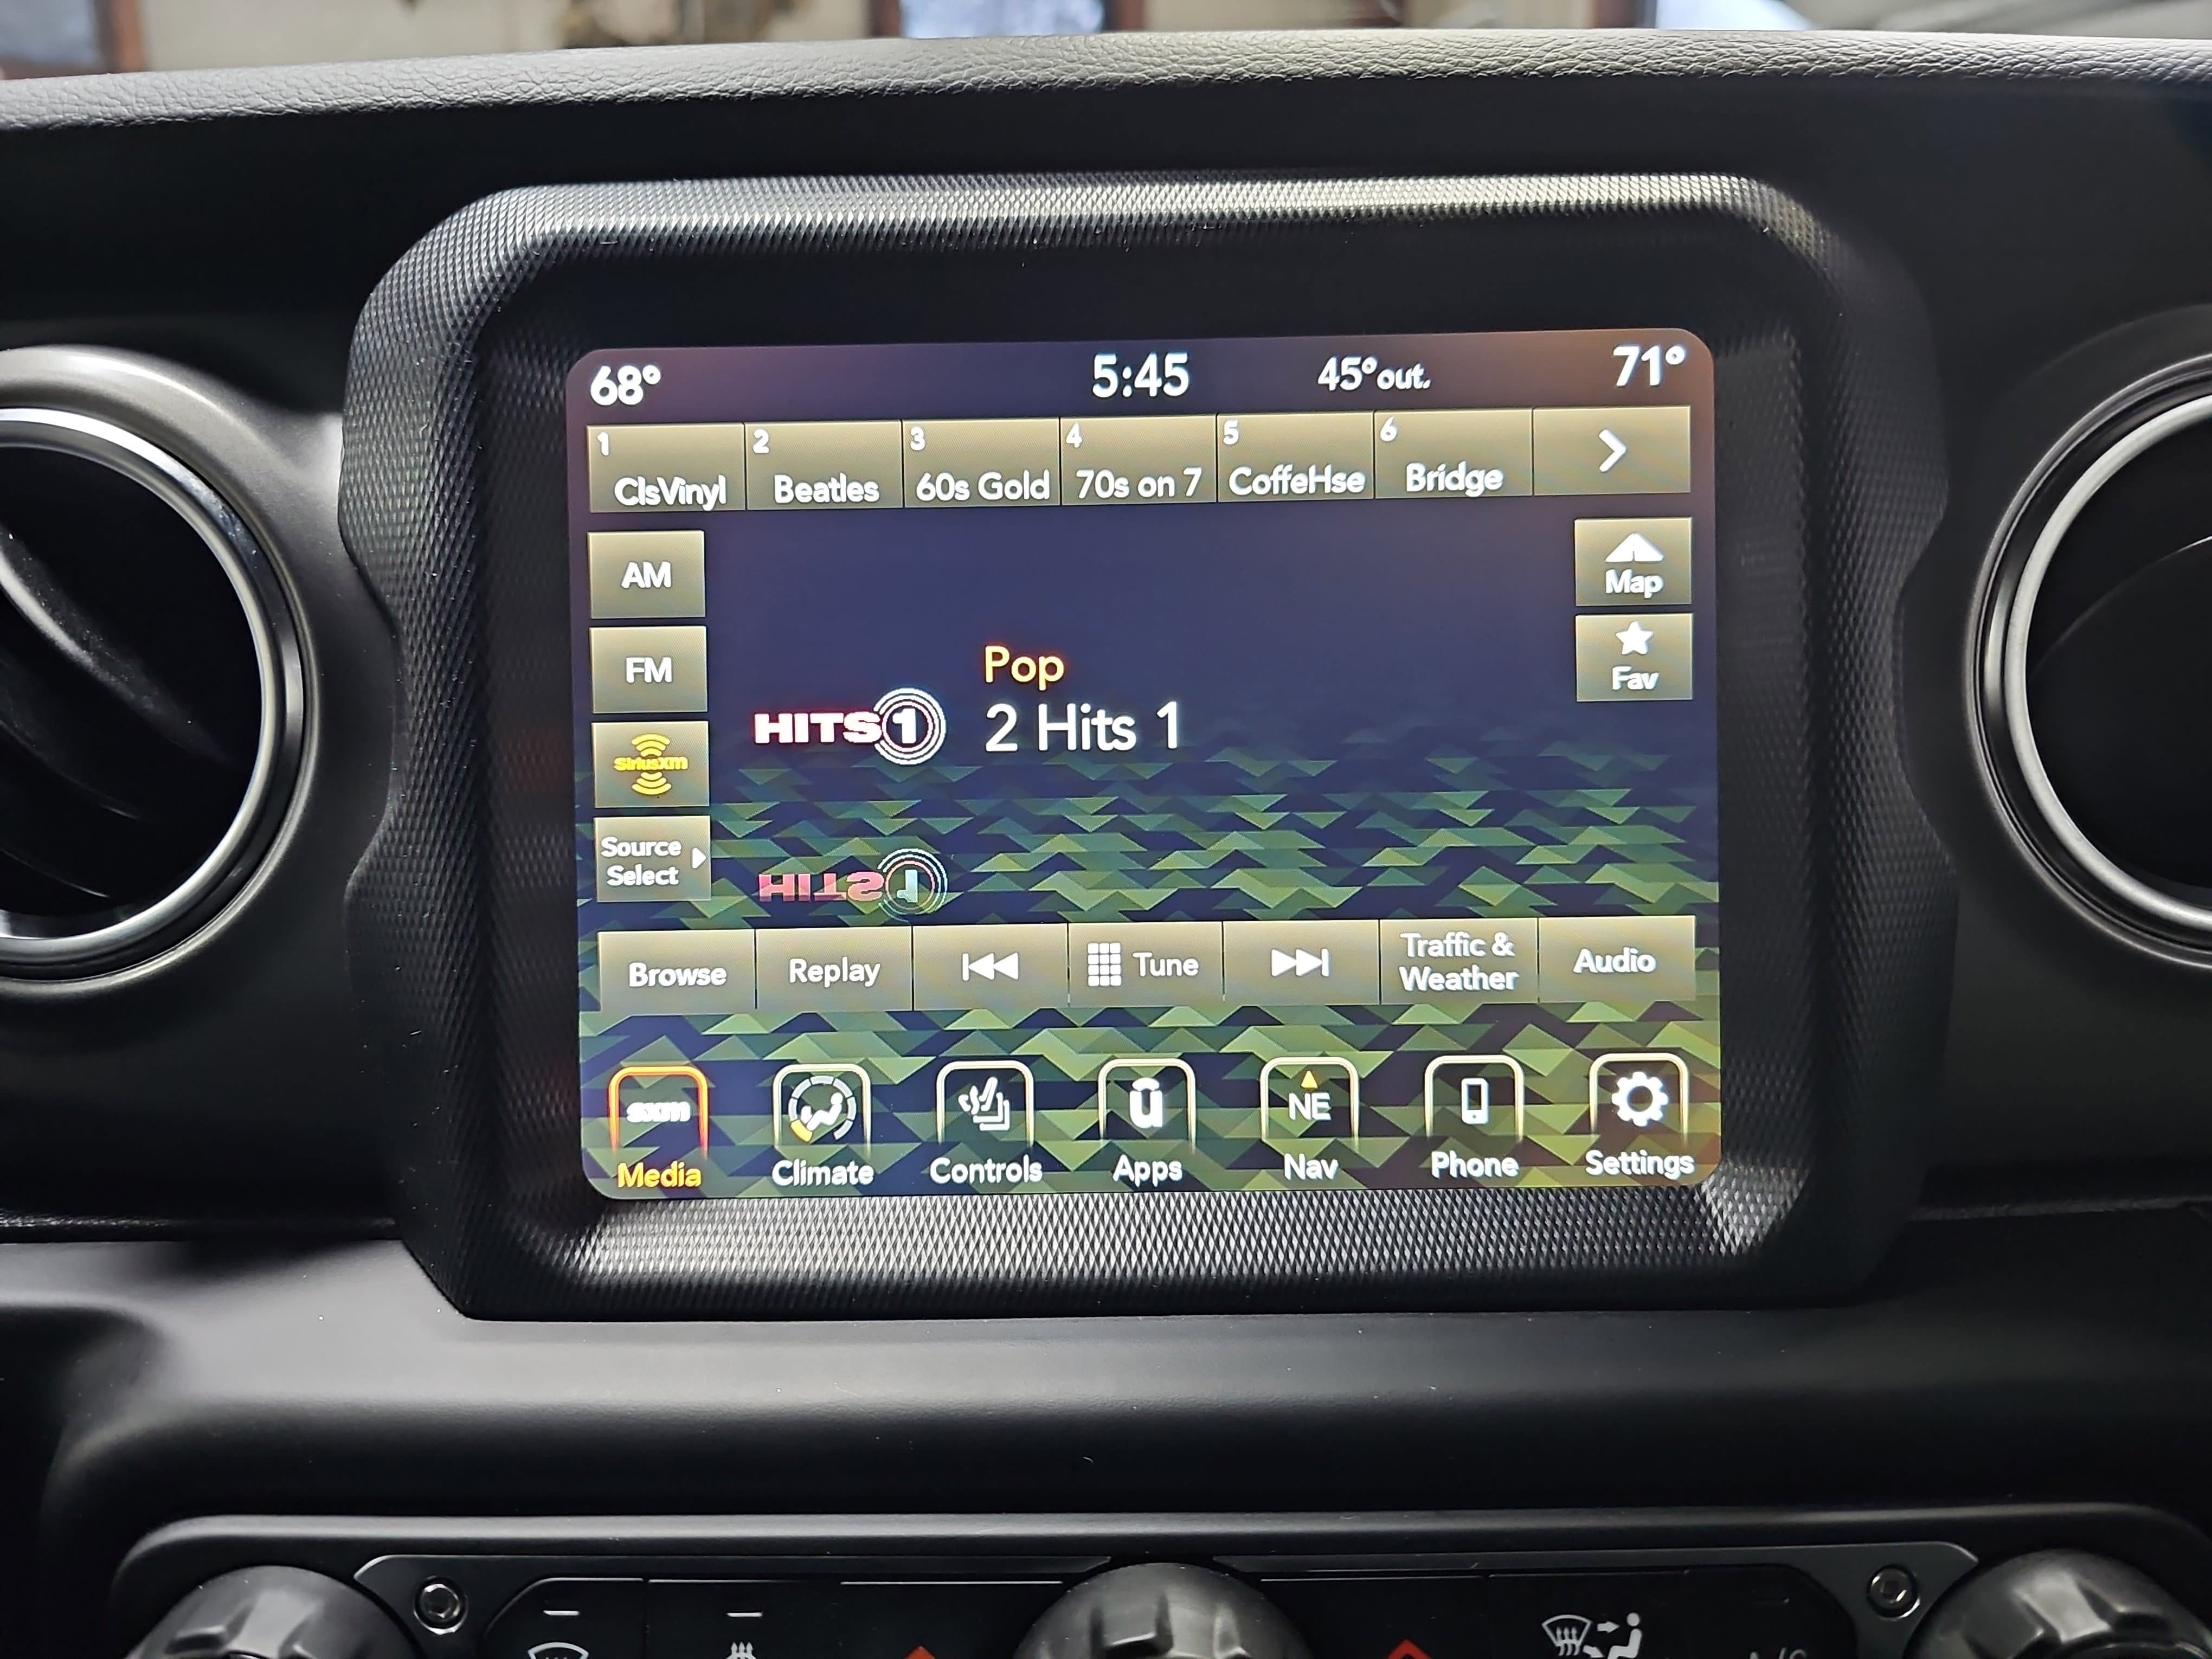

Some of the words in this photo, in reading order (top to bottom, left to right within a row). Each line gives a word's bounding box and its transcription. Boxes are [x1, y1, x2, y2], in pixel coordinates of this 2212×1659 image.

[1091, 352, 1191, 398] 5:45
[752, 428, 770, 454] 2
[909, 426, 926, 451] 3
[1065, 423, 1083, 448] 4
[1222, 420, 1239, 446] 5
[1379, 417, 1398, 441] 6
[597, 432, 610, 455] 1
[614, 474, 728, 512] ClsVinyl
[773, 472, 880, 504] Beatles
[915, 472, 972, 501] 60s
[977, 468, 1051, 501] Gold
[1075, 469, 1130, 499] 70s
[1136, 475, 1176, 498] on
[1182, 467, 1203, 497] 7
[1228, 464, 1366, 496] CoffeHse
[1405, 461, 1505, 498] Bridge
[621, 561, 672, 589] AM
[1605, 568, 1664, 599] Map
[625, 656, 673, 684] FM
[984, 644, 1065, 691] Pop
[1611, 665, 1660, 691] Fav
[985, 703, 1019, 752] 2
[1038, 702, 1137, 752] Hits
[1156, 700, 1179, 749] 1
[601, 836, 682, 858] Source
[606, 865, 679, 887] Select
[1399, 931, 1487, 959] Traffic
[1491, 931, 1516, 956] &
[789, 957, 881, 988] Replay
[1132, 951, 1200, 978] Tune
[1573, 947, 1658, 974] Audio
[628, 962, 728, 988] Browse
[1399, 965, 1519, 991] Weather
[1288, 1092, 1332, 1121] NE
[617, 1161, 703, 1188] Media
[771, 1158, 875, 1186] Climate
[929, 1155, 1043, 1185] Controls
[1111, 1153, 1184, 1187] Apps
[1283, 1153, 1339, 1181] Nav
[1430, 1150, 1520, 1179] Phone
[1584, 1149, 1696, 1181] Settings
